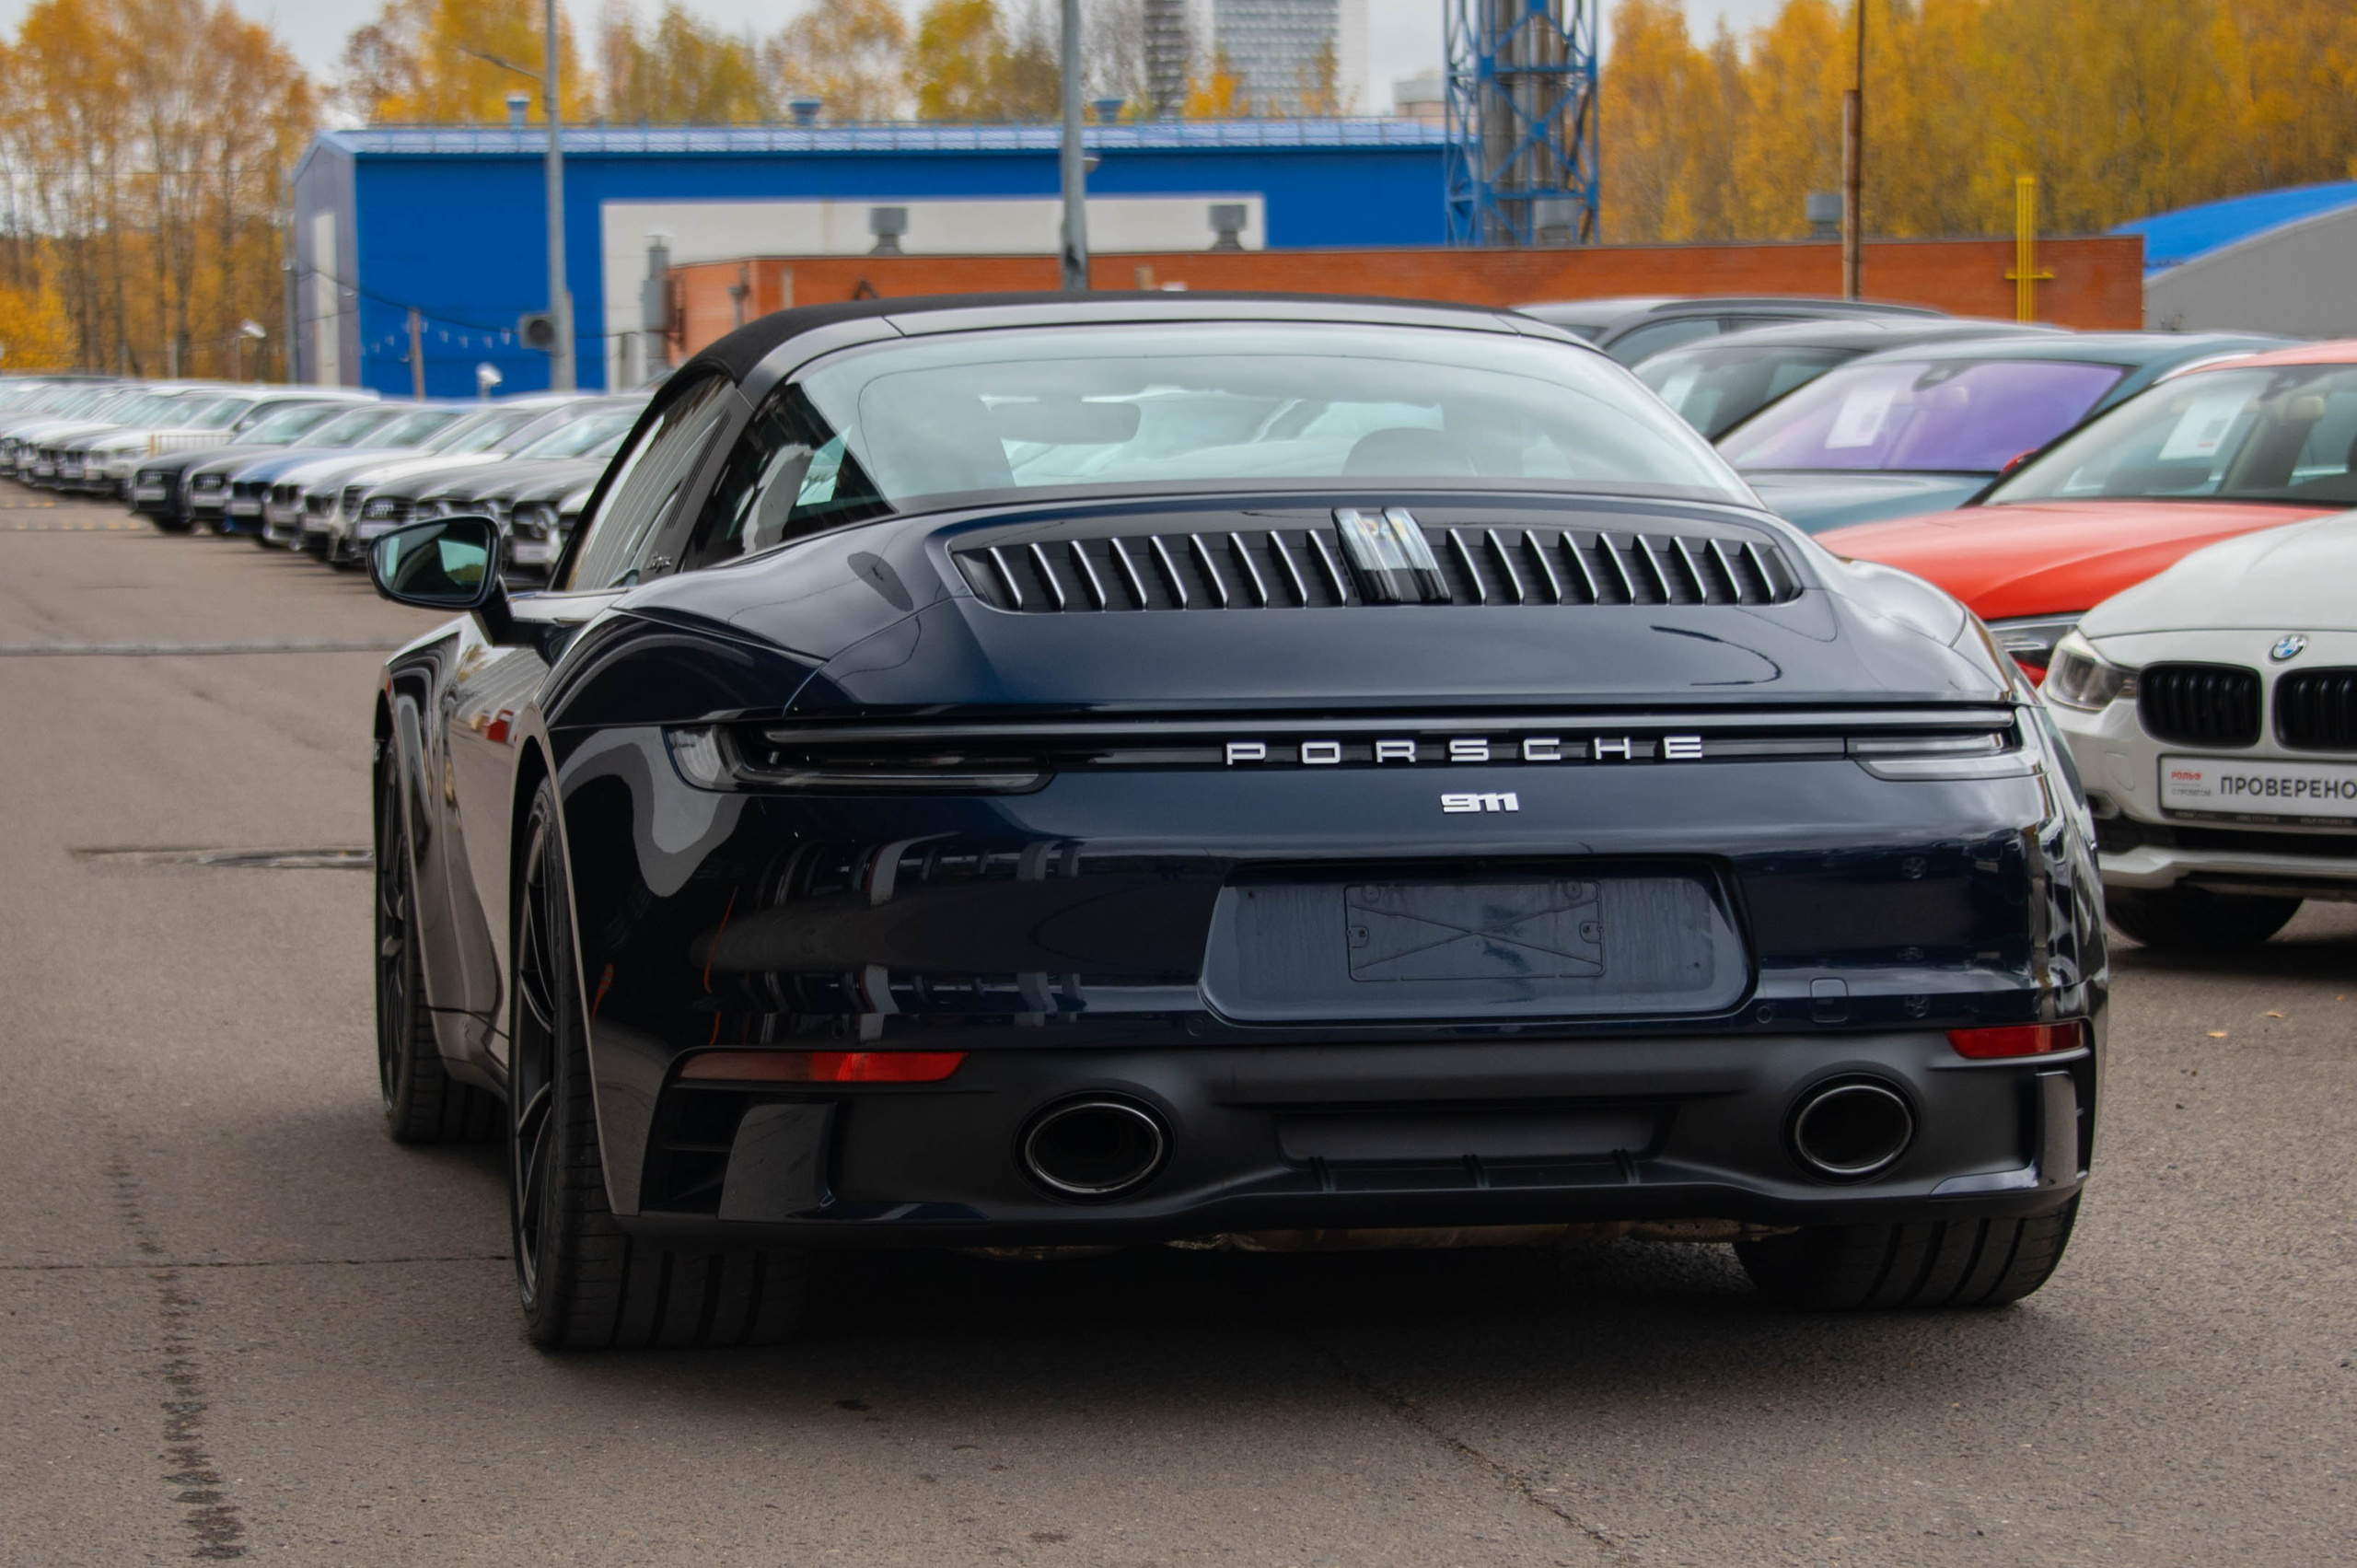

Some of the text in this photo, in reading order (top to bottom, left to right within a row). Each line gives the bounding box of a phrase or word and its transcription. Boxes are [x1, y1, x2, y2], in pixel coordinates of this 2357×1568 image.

[1225, 736, 1702, 765] PORSCHE
[2220, 775, 2357, 799] ПРОВЕРЕНО
[1441, 792, 1519, 812] 911
